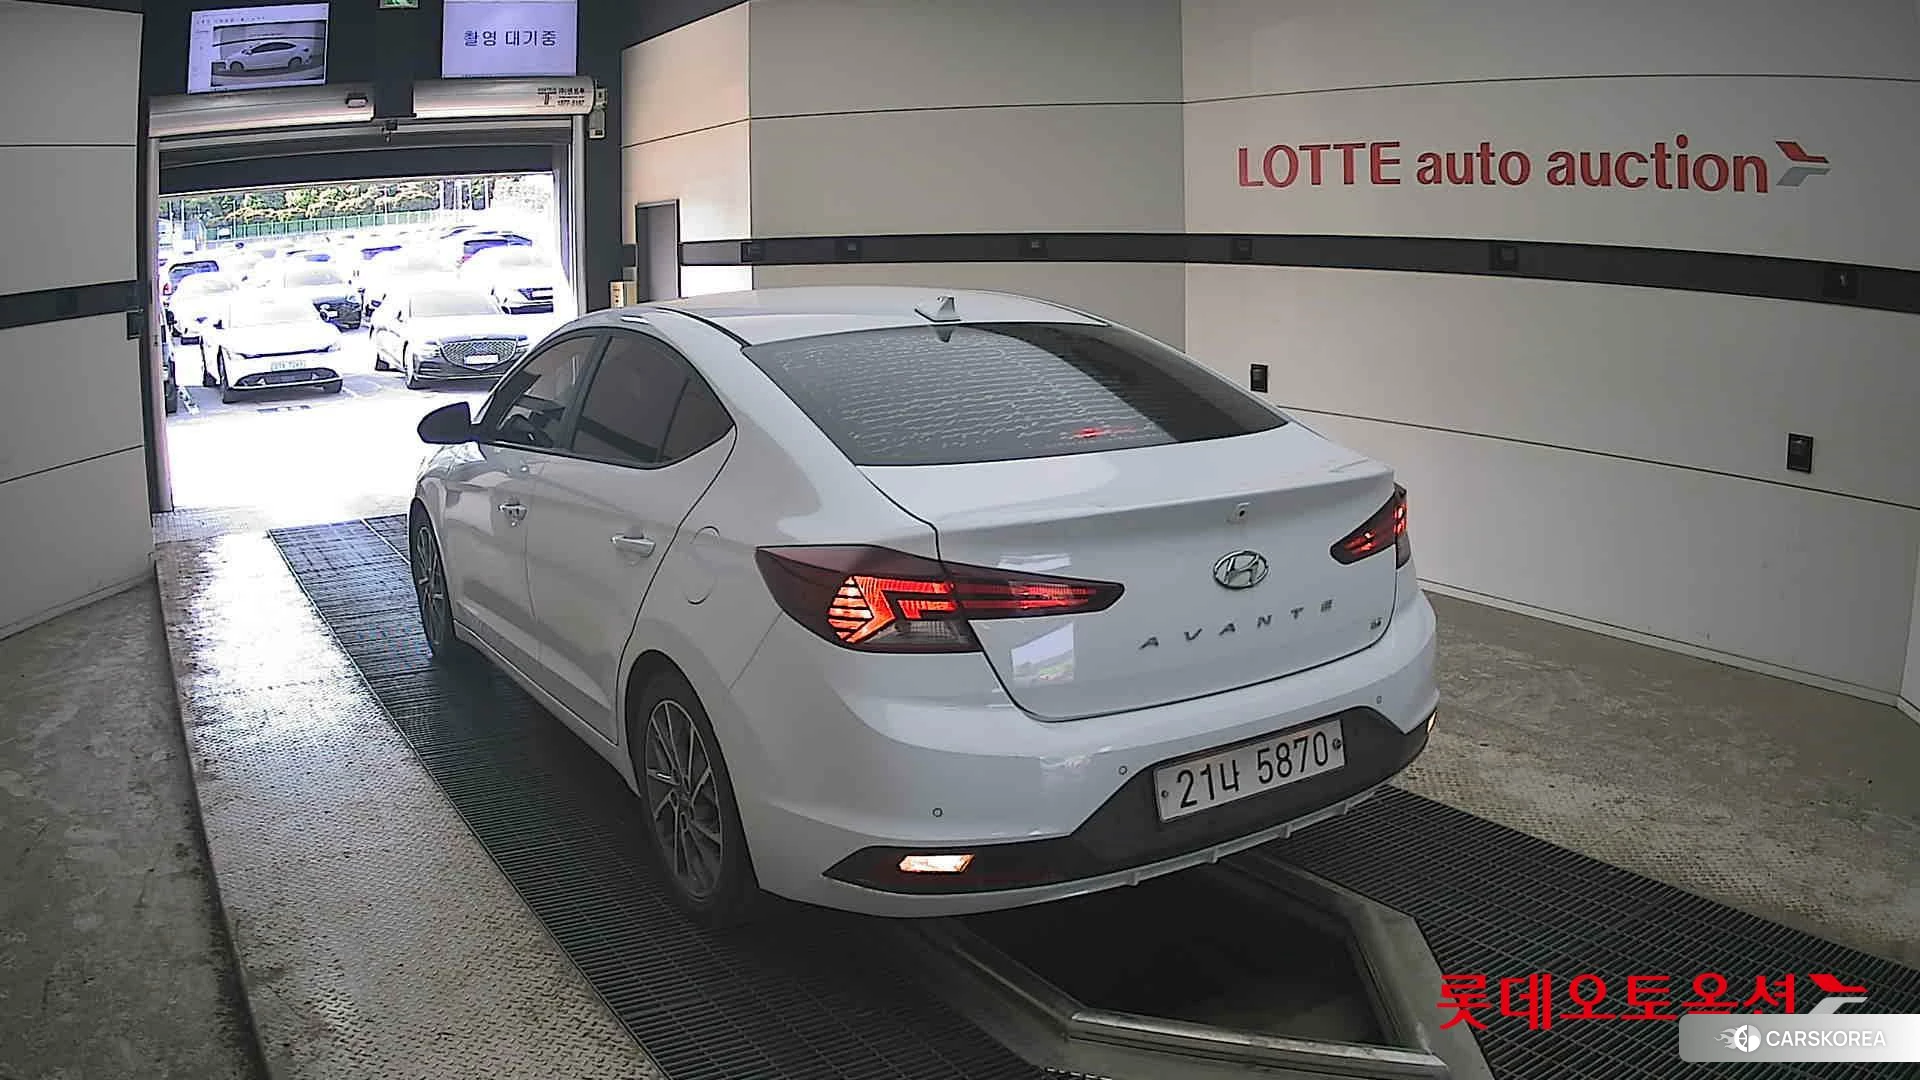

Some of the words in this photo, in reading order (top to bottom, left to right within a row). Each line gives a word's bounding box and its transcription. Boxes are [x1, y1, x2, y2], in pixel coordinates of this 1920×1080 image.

[464, 30, 497, 47] 촬영
[505, 30, 557, 47] 대기중
[1238, 141, 1402, 188] LOTTE
[1415, 143, 1531, 186] auto
[1546, 134, 1769, 193] auction
[1138, 599, 1334, 650] AVANTE
[1176, 759, 1240, 809] 21나
[1256, 731, 1329, 784] 5870
